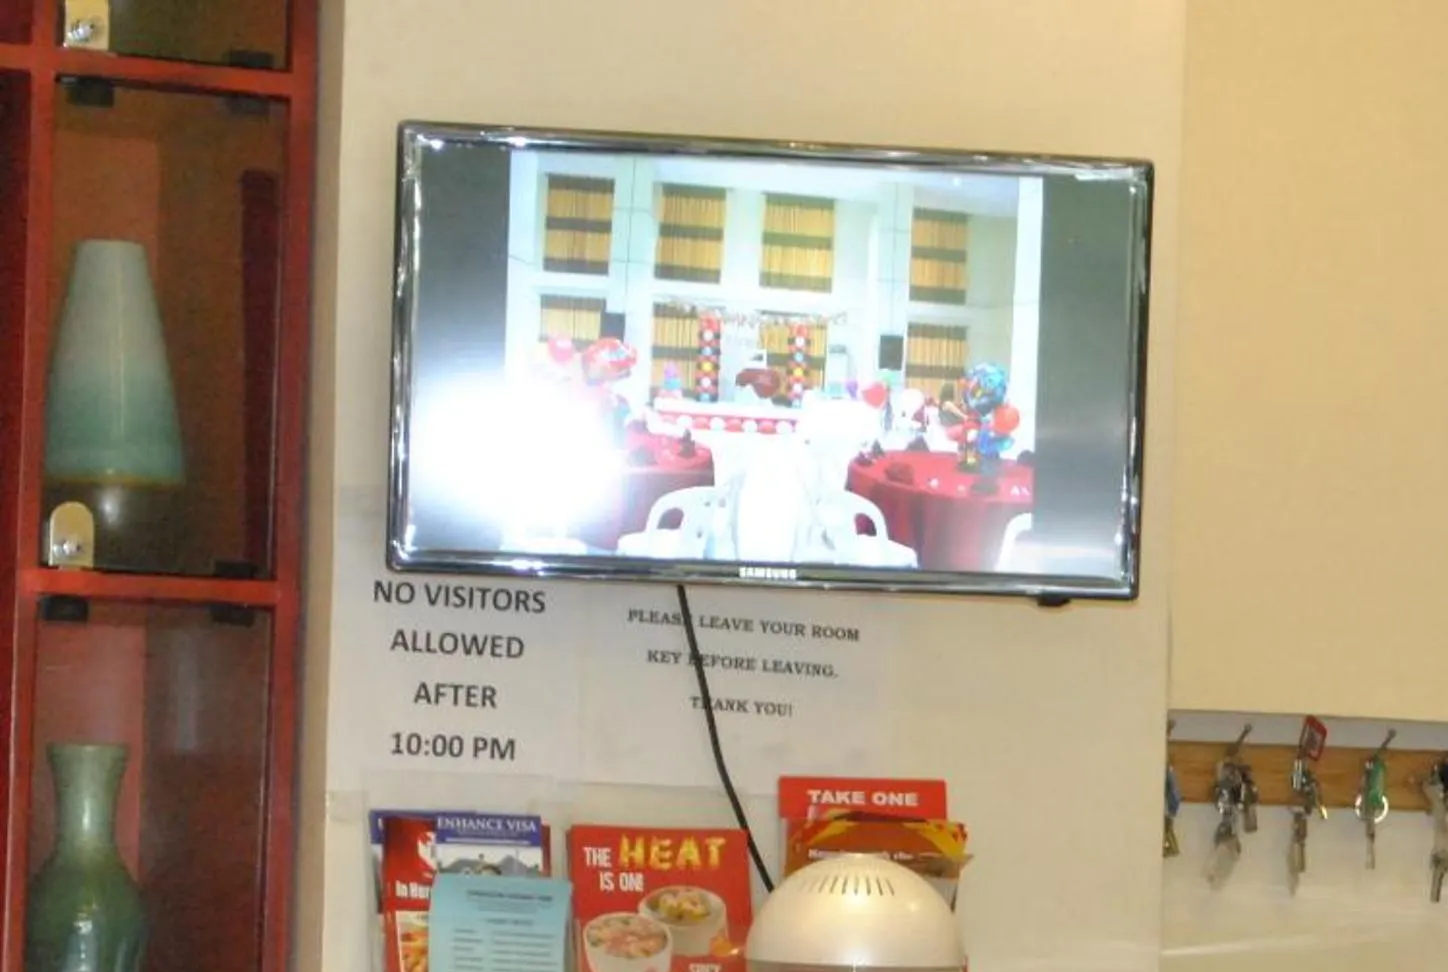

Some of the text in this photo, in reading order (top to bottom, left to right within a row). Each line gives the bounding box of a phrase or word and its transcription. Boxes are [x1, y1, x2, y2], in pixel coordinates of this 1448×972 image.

[373, 580, 547, 614] NO VISITORS
[627, 608, 860, 642] PLEAS LEAVE YOUR ROOM
[390, 628, 525, 659] ALLOWED
[647, 649, 682, 665] KEY
[413, 681, 498, 709] AFTER
[754, 701, 793, 718] YOU!
[390, 732, 517, 761] 10:00 PM
[807, 789, 920, 807] TAKE ONE
[437, 816, 538, 833] ENHANCE VISA
[584, 833, 727, 870] THE HEAT
[599, 871, 615, 892] IS
